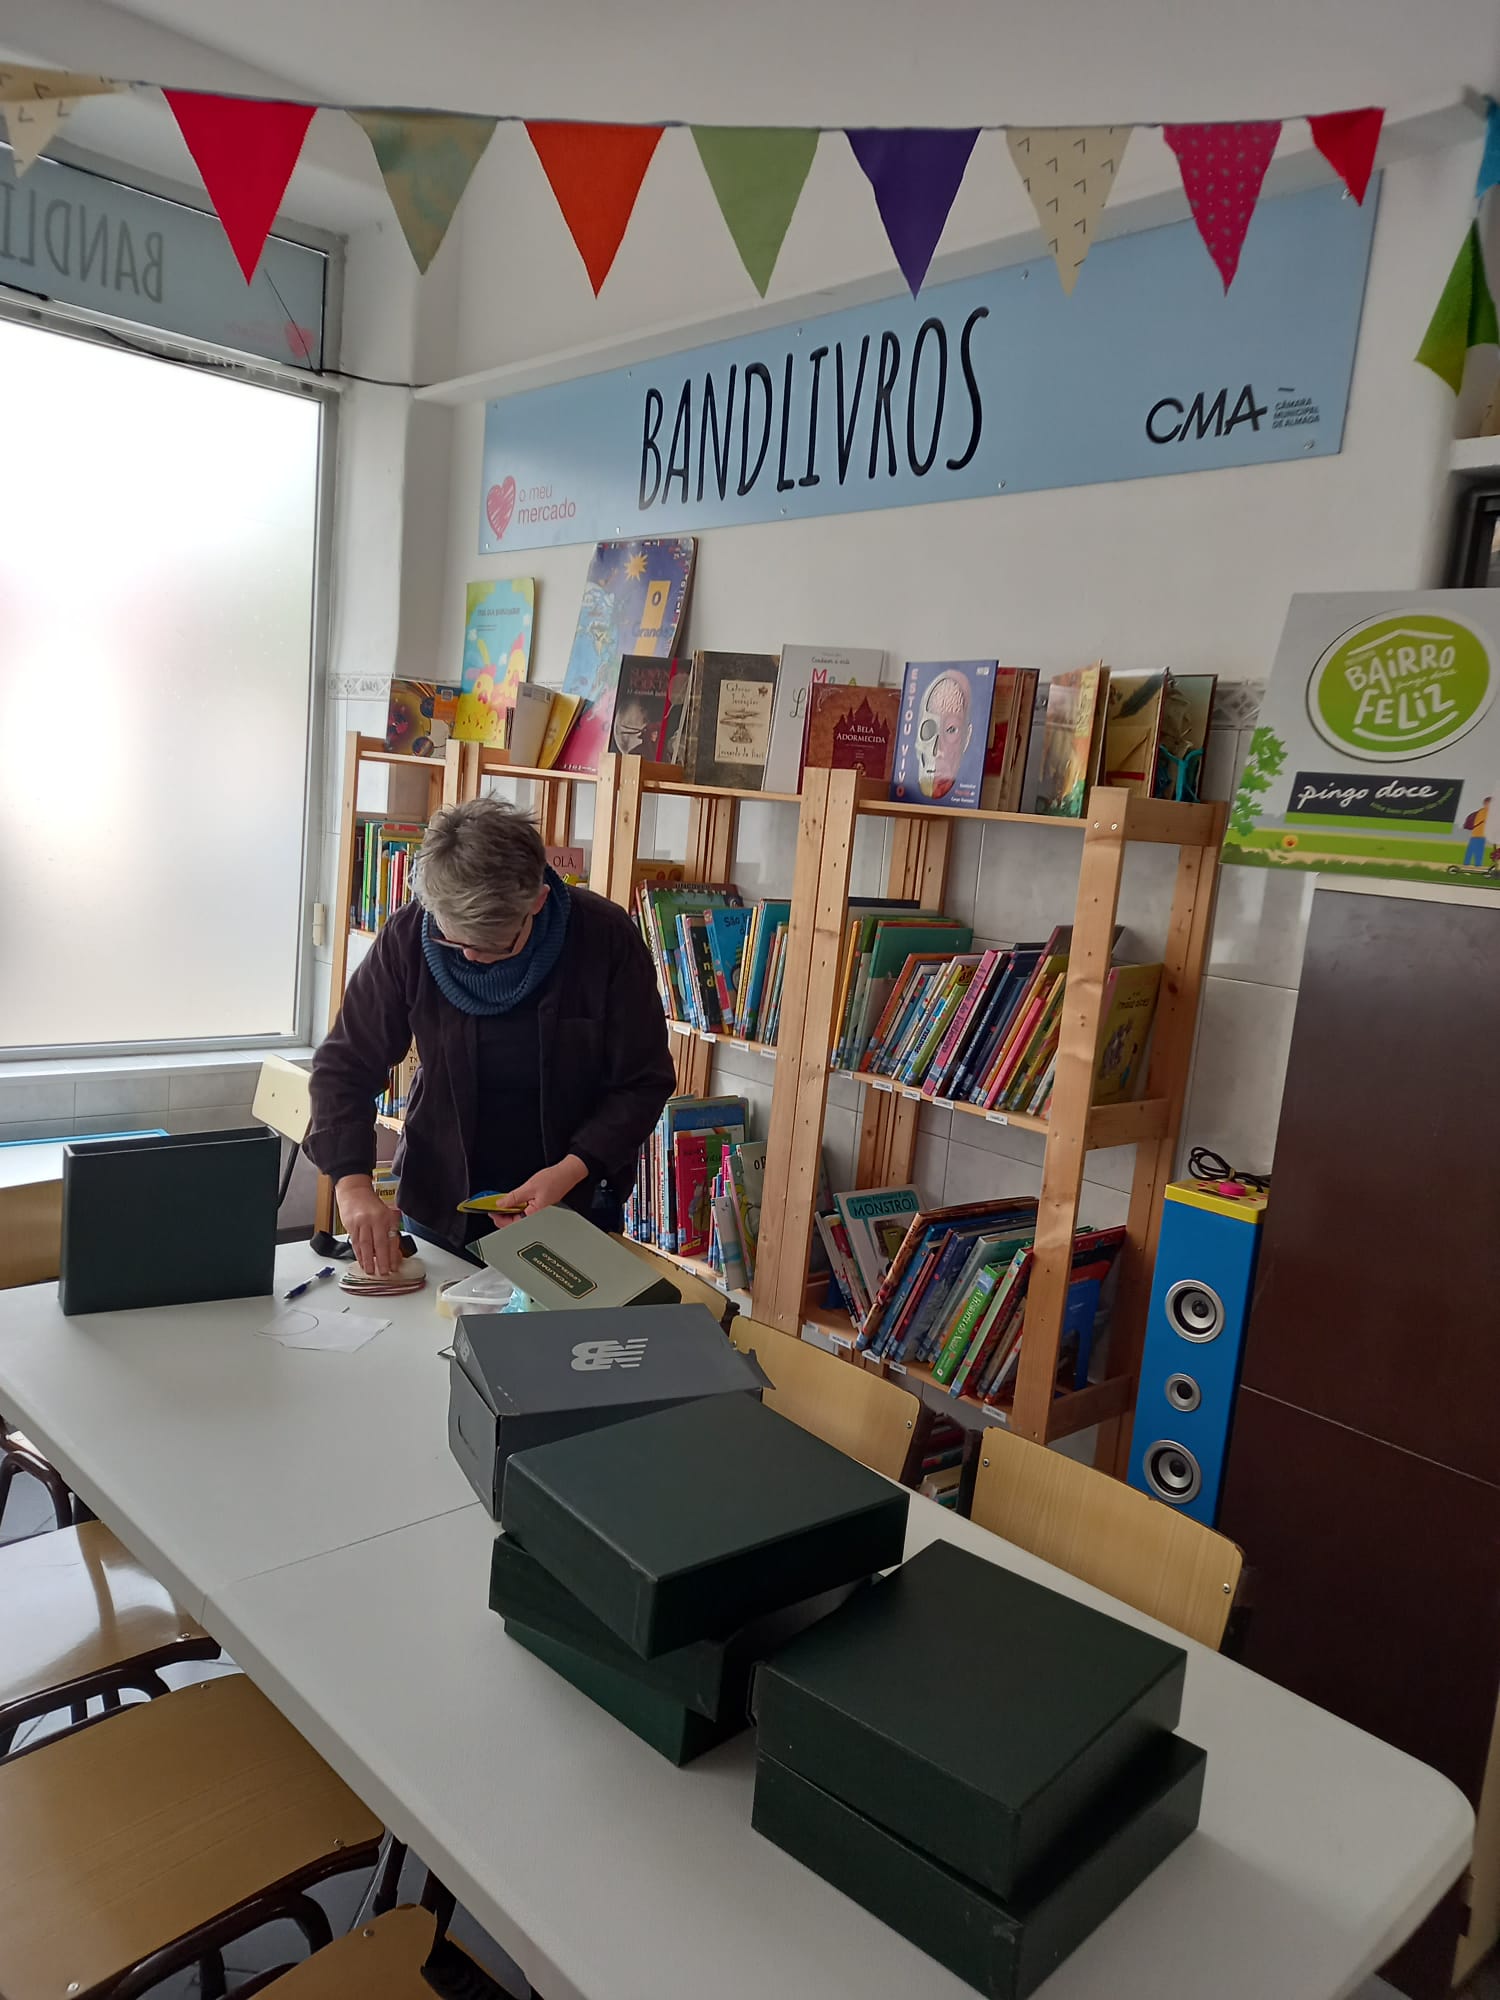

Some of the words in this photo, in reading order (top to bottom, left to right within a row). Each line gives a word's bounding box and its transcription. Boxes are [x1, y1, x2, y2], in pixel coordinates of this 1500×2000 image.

[638, 306, 989, 511] BANDLIVROS
[1146, 383, 1268, 444] CMA
[530, 484, 552, 500] meu
[518, 496, 576, 525] mercado
[903, 668, 919, 736] ESTOU
[836, 733, 886, 744] ADORMECIDA
[857, 725, 874, 734] BELA
[896, 744, 909, 798] VIVO
[1297, 783, 1369, 810] pingo
[1375, 780, 1440, 800] doce
[723, 915, 740, 928] São
